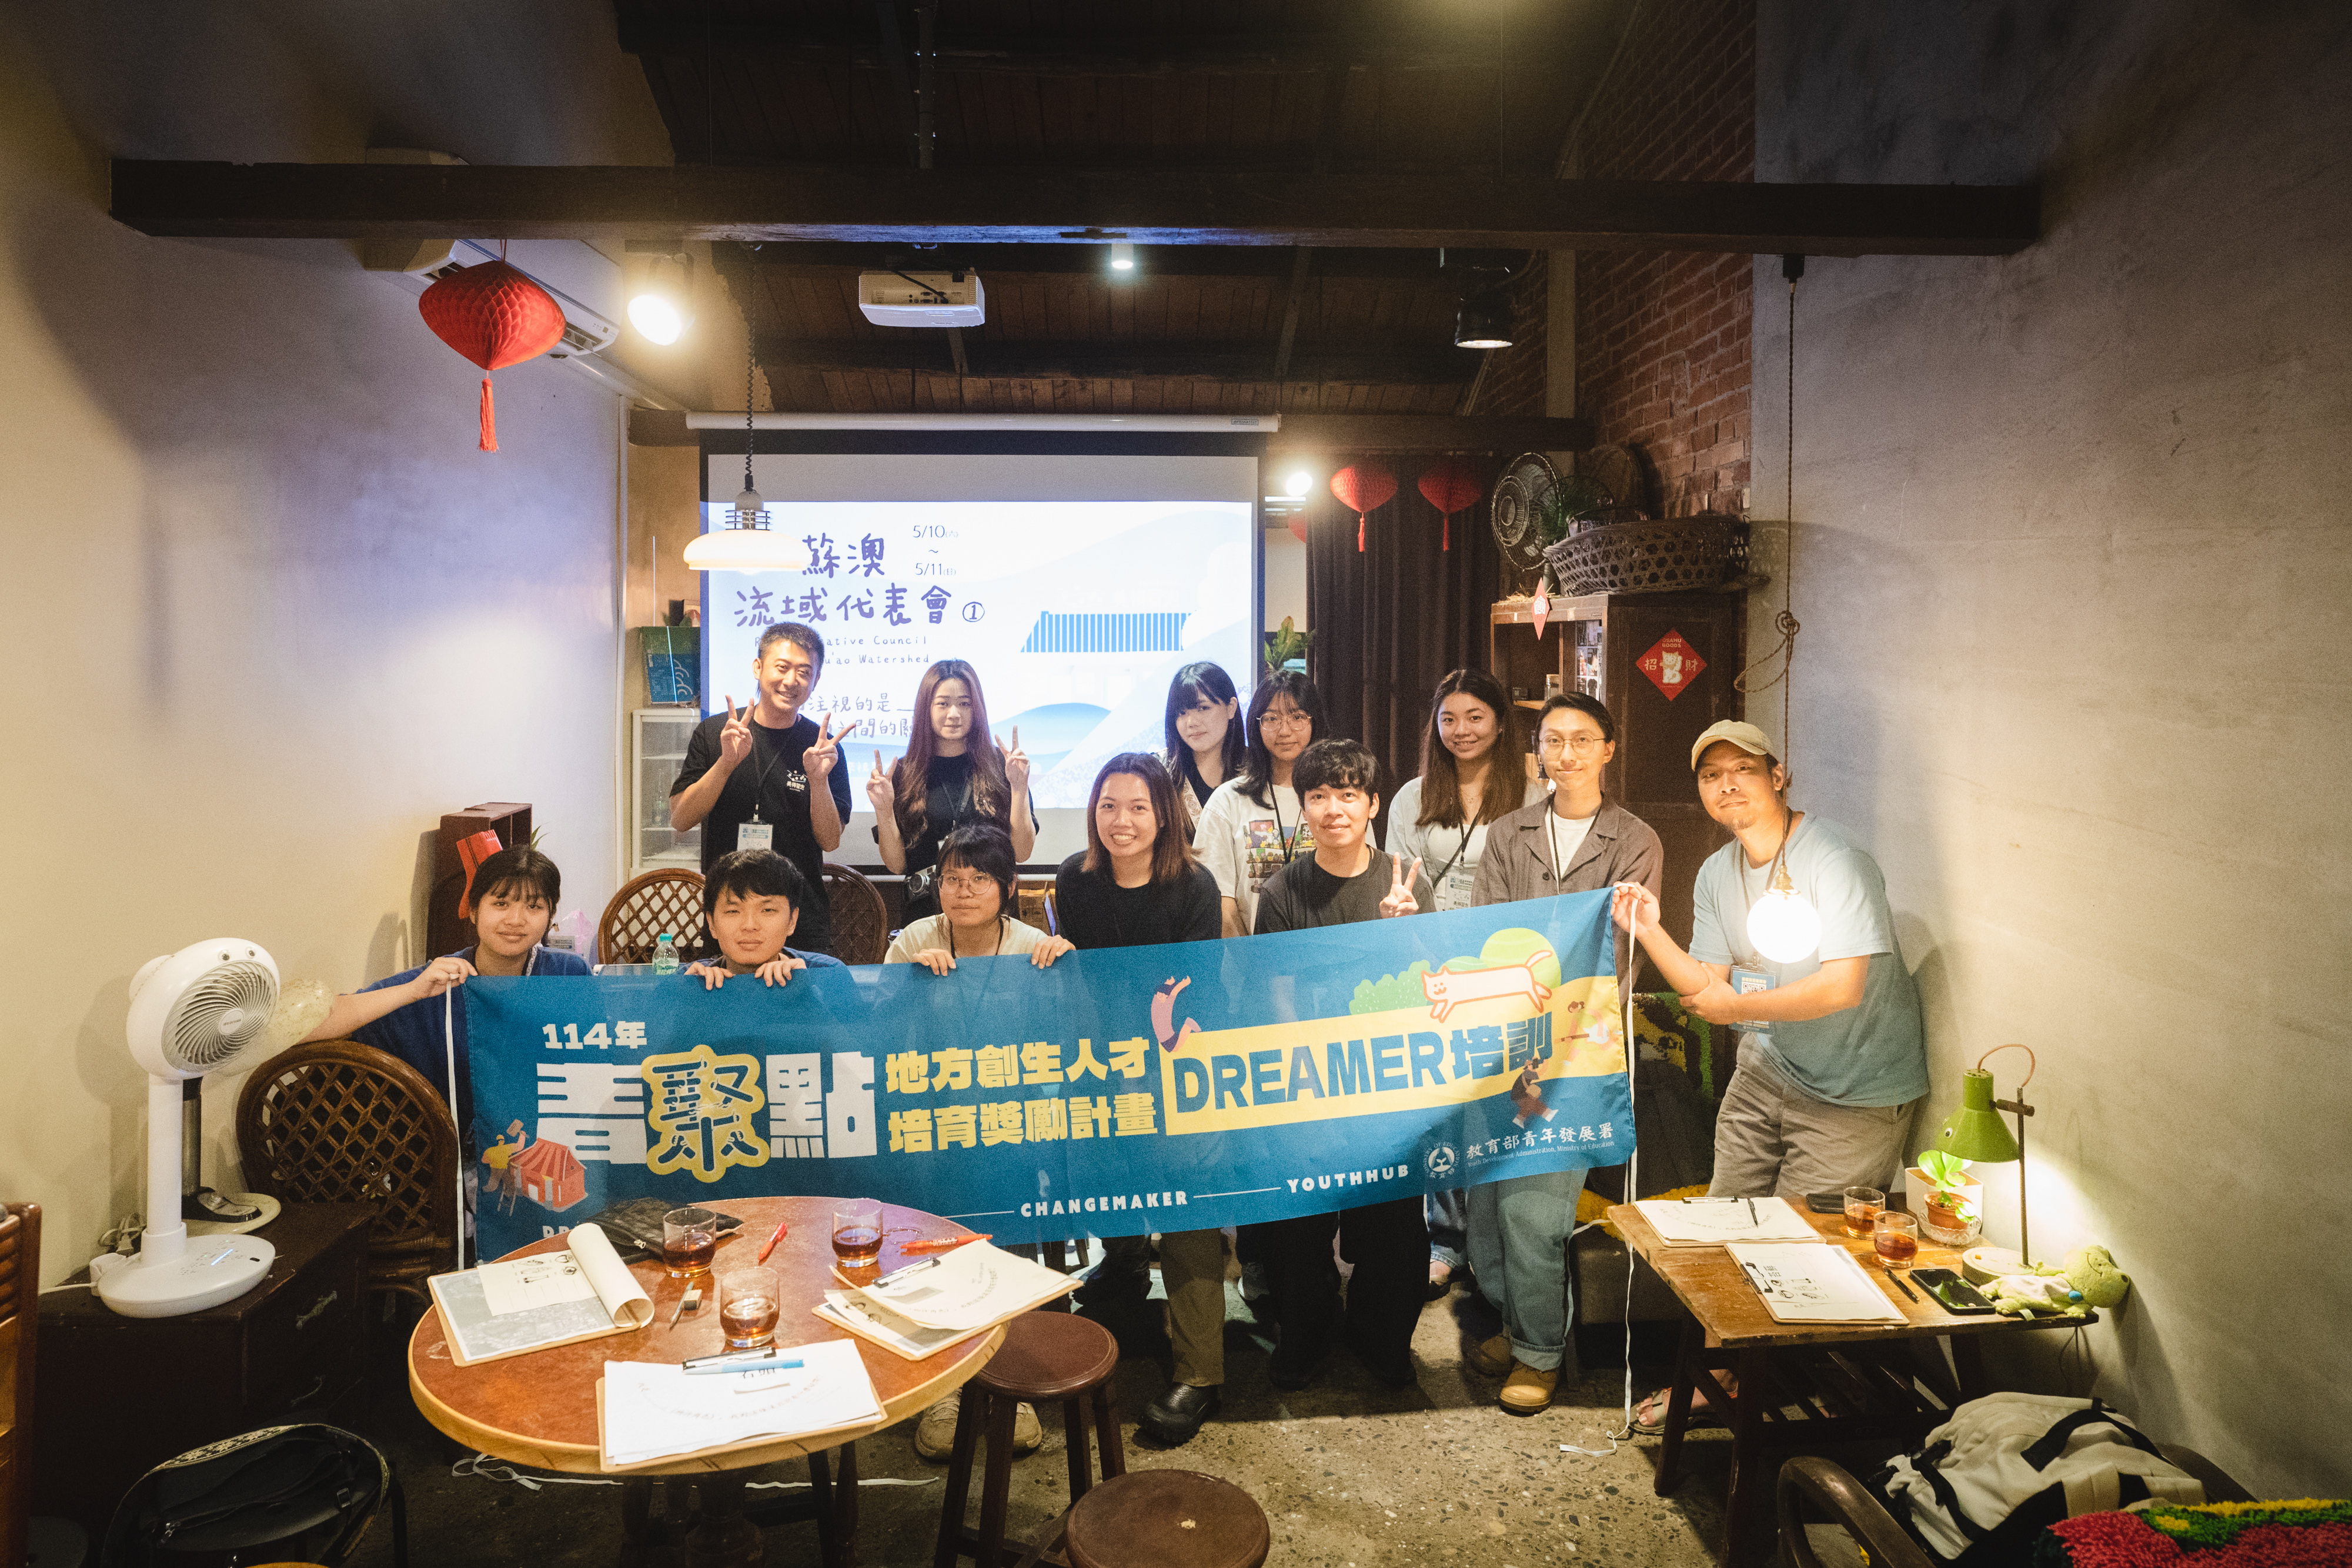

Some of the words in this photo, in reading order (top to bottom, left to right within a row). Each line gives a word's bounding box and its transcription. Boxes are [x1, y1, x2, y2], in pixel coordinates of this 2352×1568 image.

[734, 583, 952, 627] 流域代表會
[874, 635, 927, 646] Council
[858, 654, 930, 664] Watershed
[1645, 658, 1657, 671] 招
[1685, 658, 1698, 671] 財
[542, 1021, 647, 1049] 114年
[886, 1037, 1150, 1094] 地方創生人才
[888, 1092, 1157, 1154] 培育獎勵計畫
[1466, 1122, 1614, 1160] 教育部青年發展署
[1467, 1158, 1482, 1168] Youth
[1482, 1152, 1515, 1165] Development
[1515, 1147, 1556, 1158] Administration,
[1557, 1144, 1580, 1154] Ministry
[1588, 1141, 1615, 1149] Education
[1021, 1191, 1188, 1217] CHANGEMAKER
[1286, 1164, 1409, 1193] YOUTHHUB
